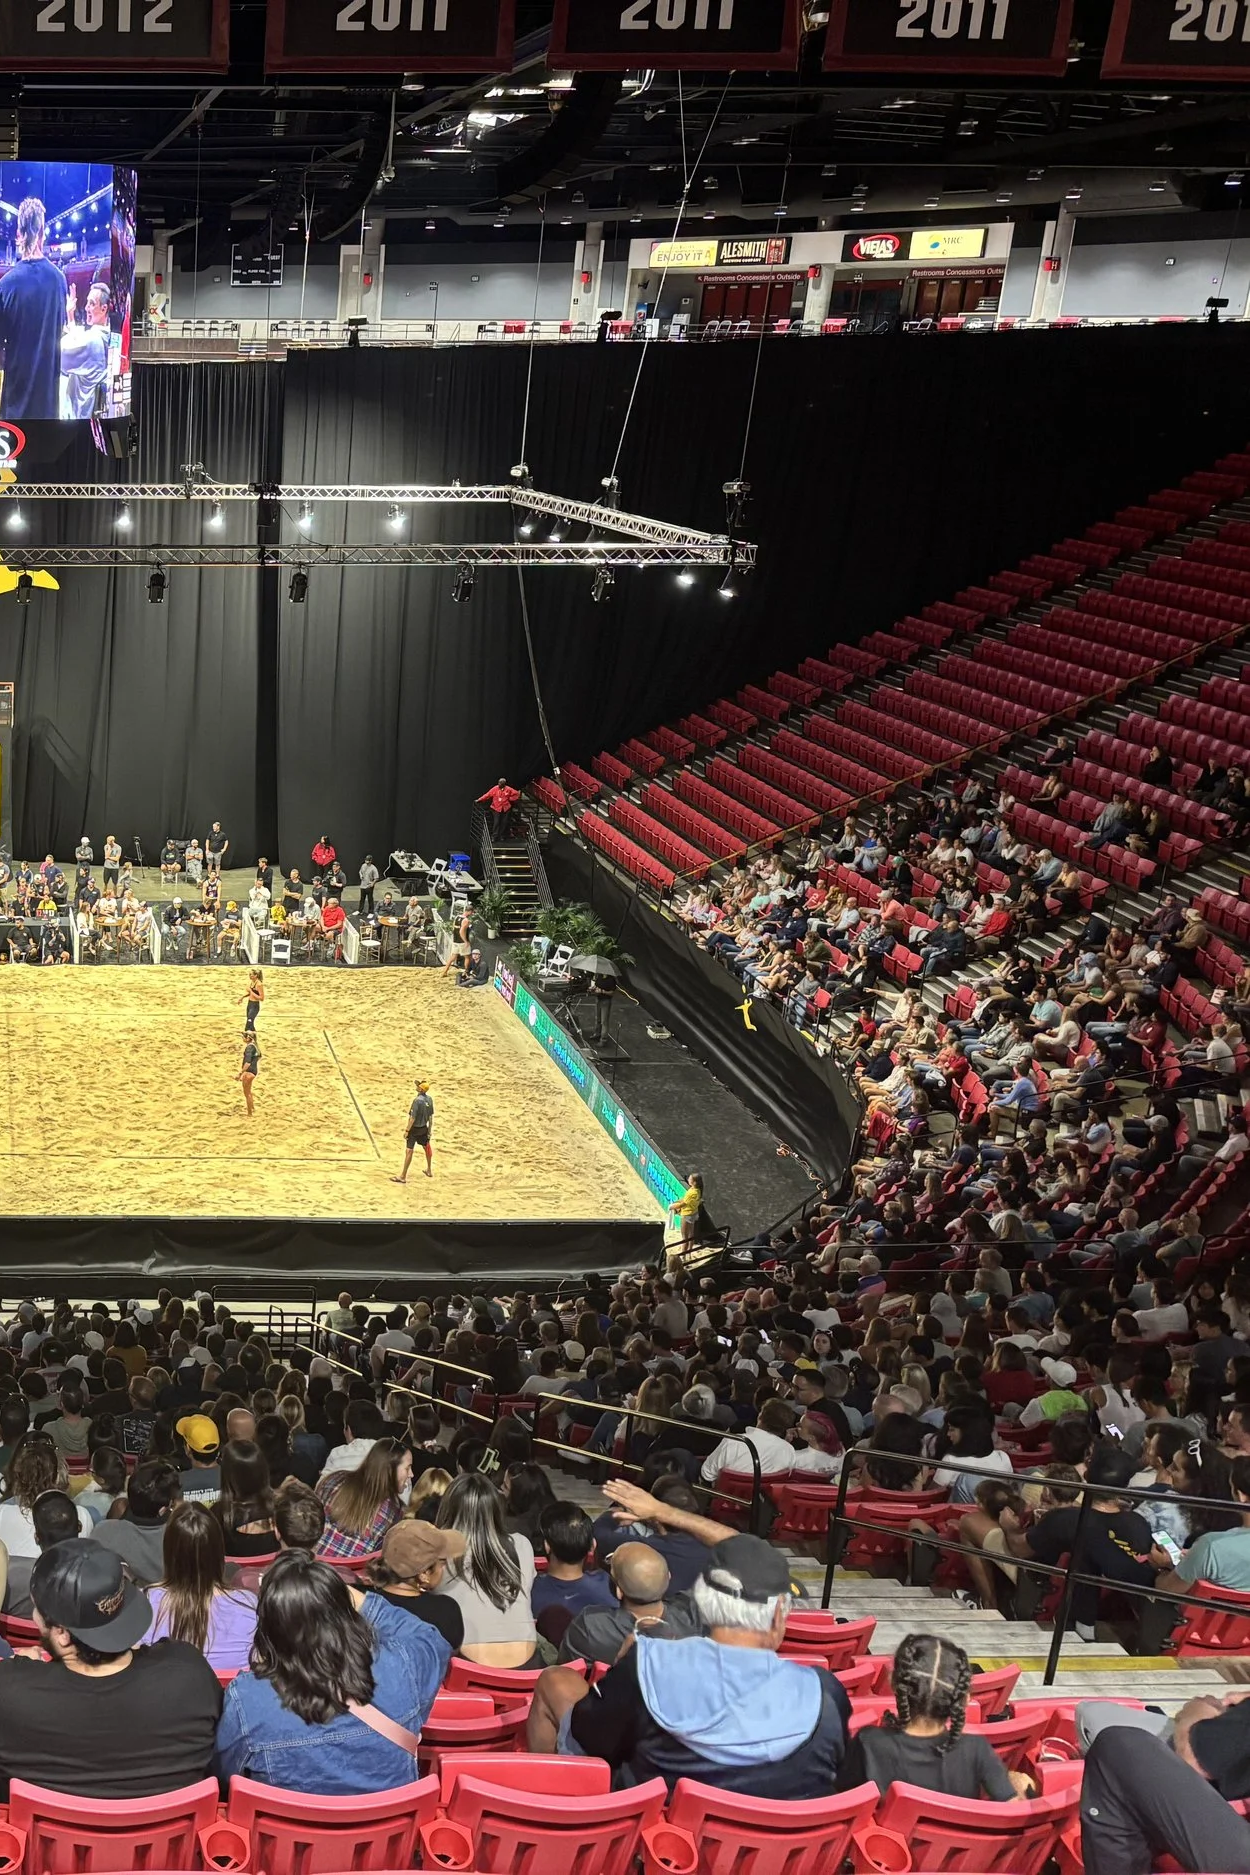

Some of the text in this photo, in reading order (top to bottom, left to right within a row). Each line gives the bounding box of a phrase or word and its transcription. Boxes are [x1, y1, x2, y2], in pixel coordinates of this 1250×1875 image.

[36, 0, 173, 32] 2012
[336, 0, 448, 31] 2011
[619, 0, 734, 30] 2011
[896, 0, 1009, 39] 2011
[858, 238, 894, 256] VIEJAS
[943, 235, 963, 244] MRC
[657, 252, 703, 262] ENJOY IT
[720, 240, 767, 260] ALESMITH
[912, 267, 1004, 277] Restrooms Concessions Outsi
